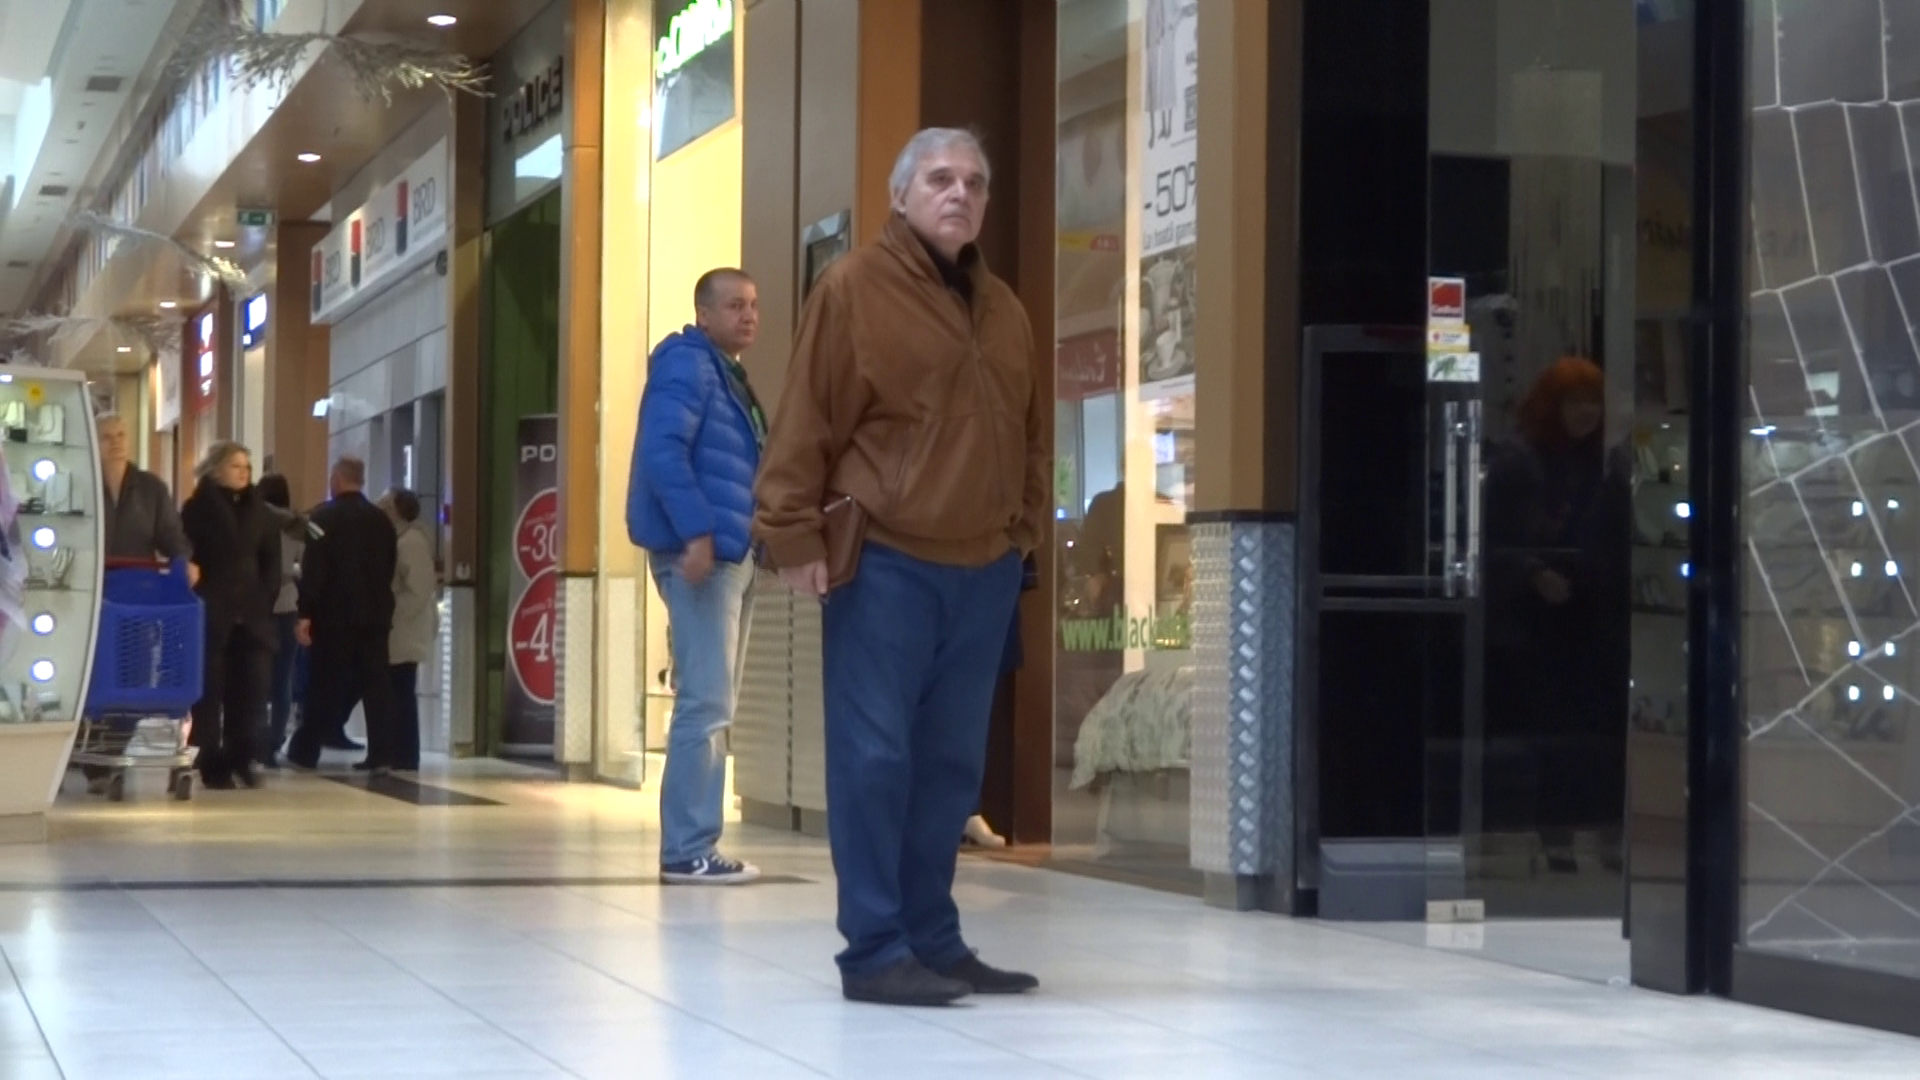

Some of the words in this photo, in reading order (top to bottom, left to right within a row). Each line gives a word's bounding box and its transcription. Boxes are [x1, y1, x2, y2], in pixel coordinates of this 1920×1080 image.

[413, 176, 436, 227] BRD
[514, 611, 556, 663] -4
[1061, 602, 1188, 651] www.black
